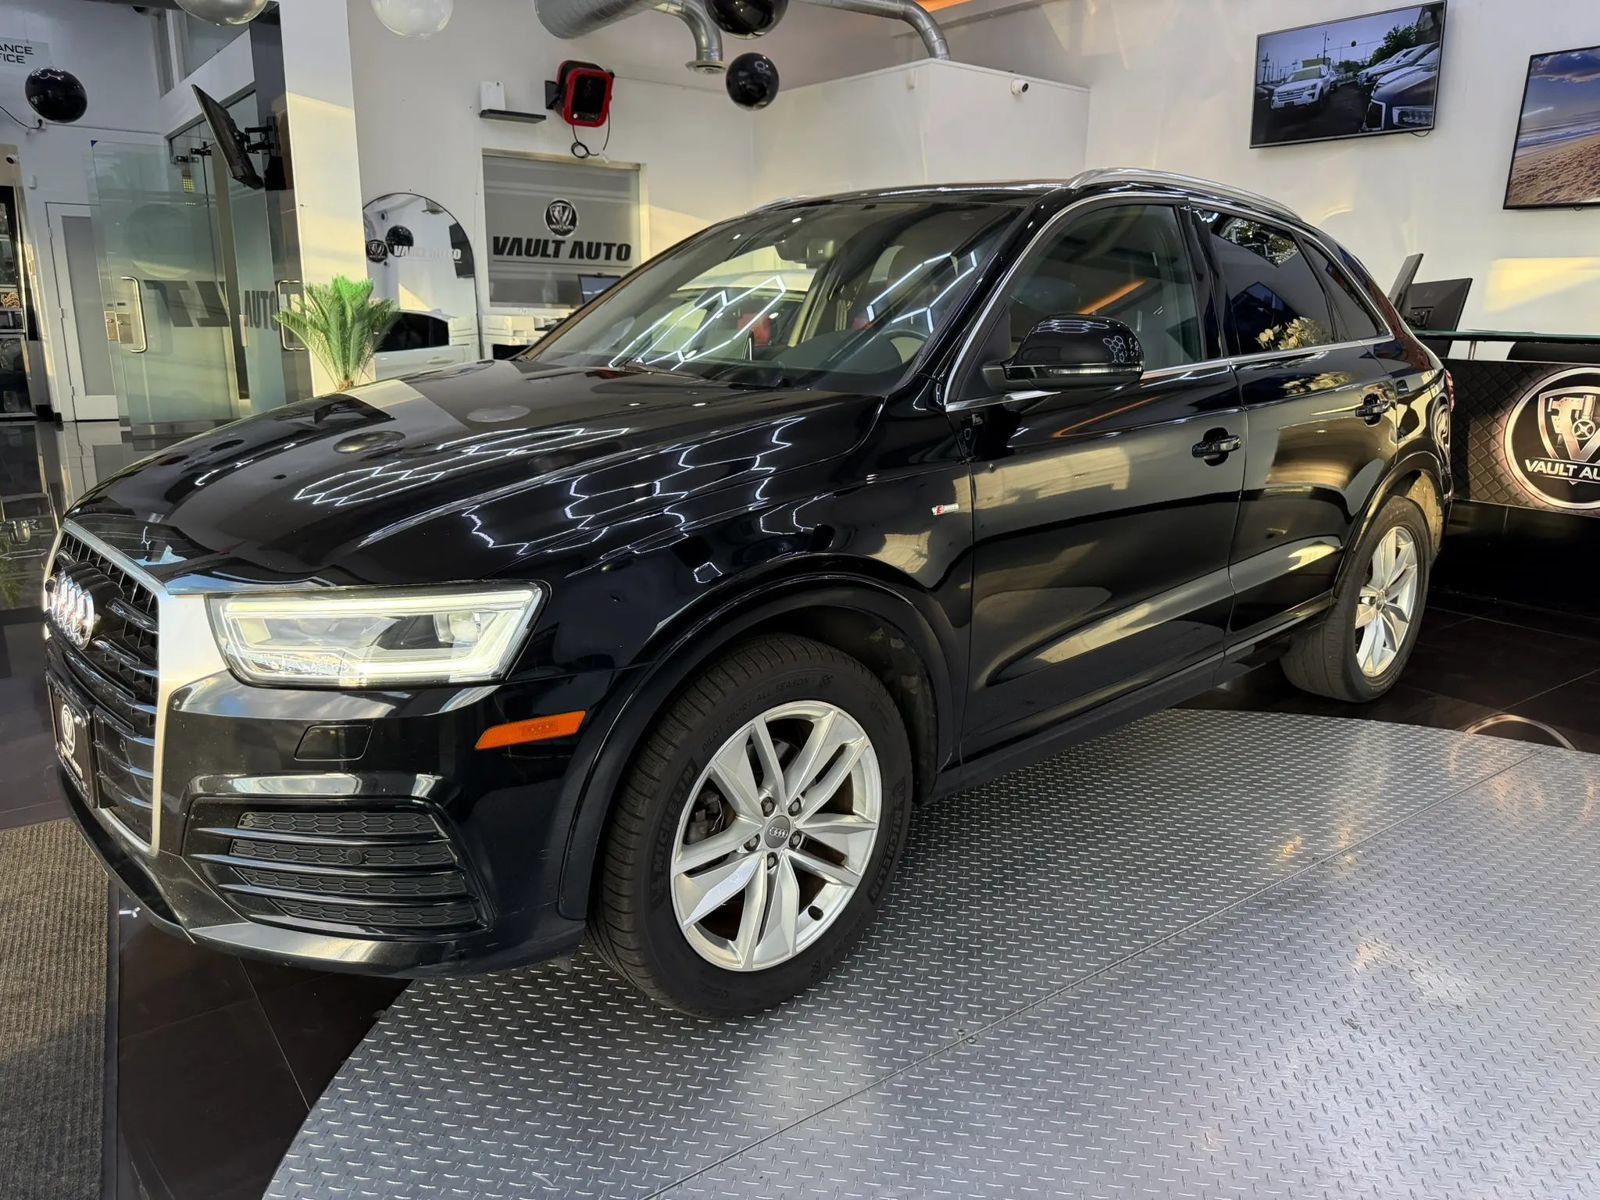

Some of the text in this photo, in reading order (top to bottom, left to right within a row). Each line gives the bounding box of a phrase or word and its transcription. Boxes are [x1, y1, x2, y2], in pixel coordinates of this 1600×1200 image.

[493, 236, 632, 262] VAULT AUTO
[1525, 459, 1578, 477] VAULT
